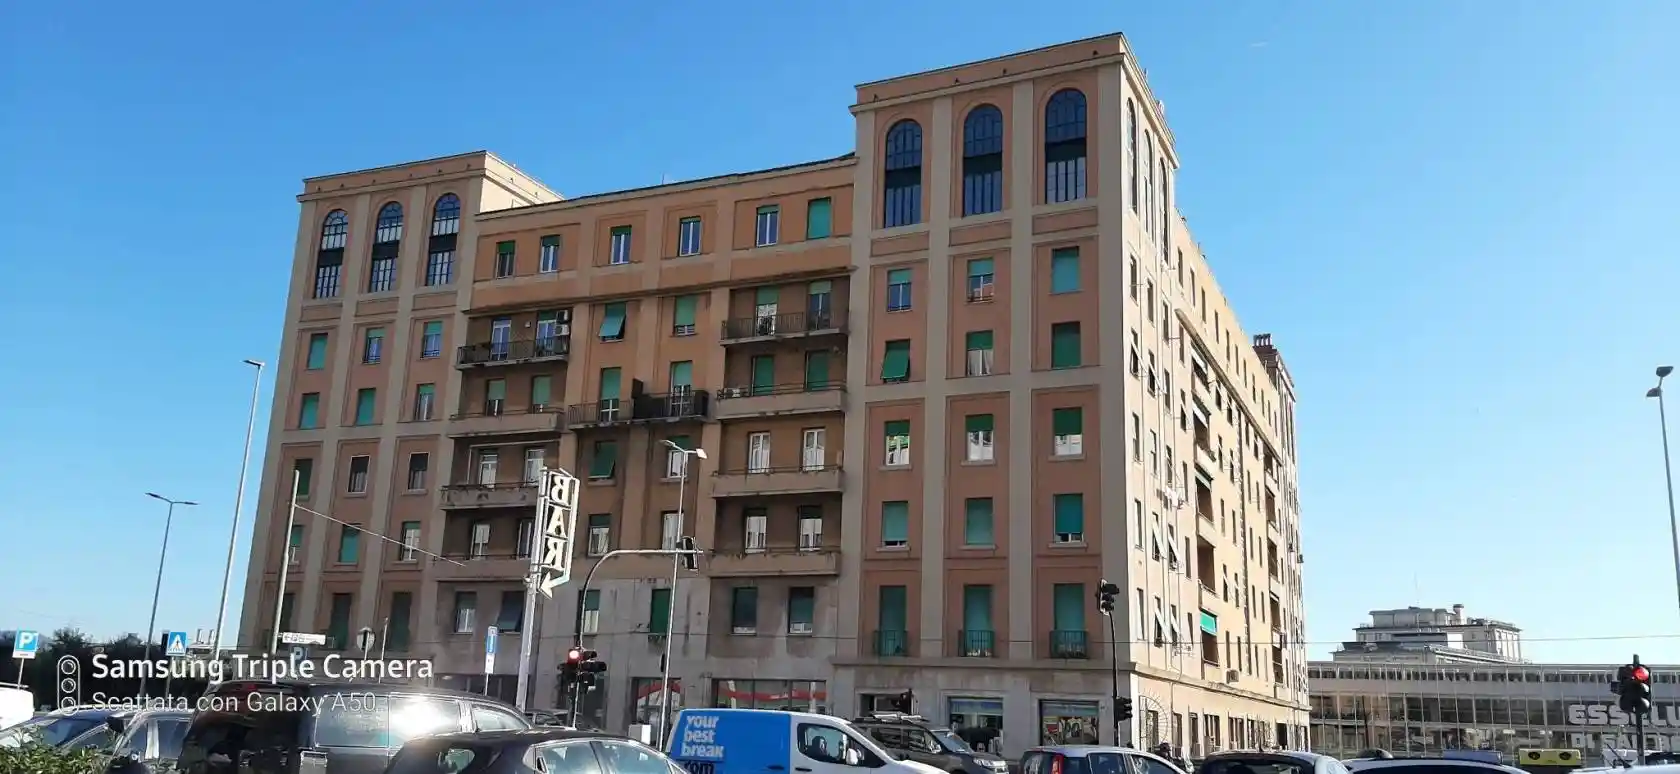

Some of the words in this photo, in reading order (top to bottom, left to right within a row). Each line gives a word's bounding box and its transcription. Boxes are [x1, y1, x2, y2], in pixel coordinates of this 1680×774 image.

[19, 631, 33, 649] P
[686, 715, 720, 729] your
[683, 727, 716, 743] best
[680, 742, 724, 757] break
